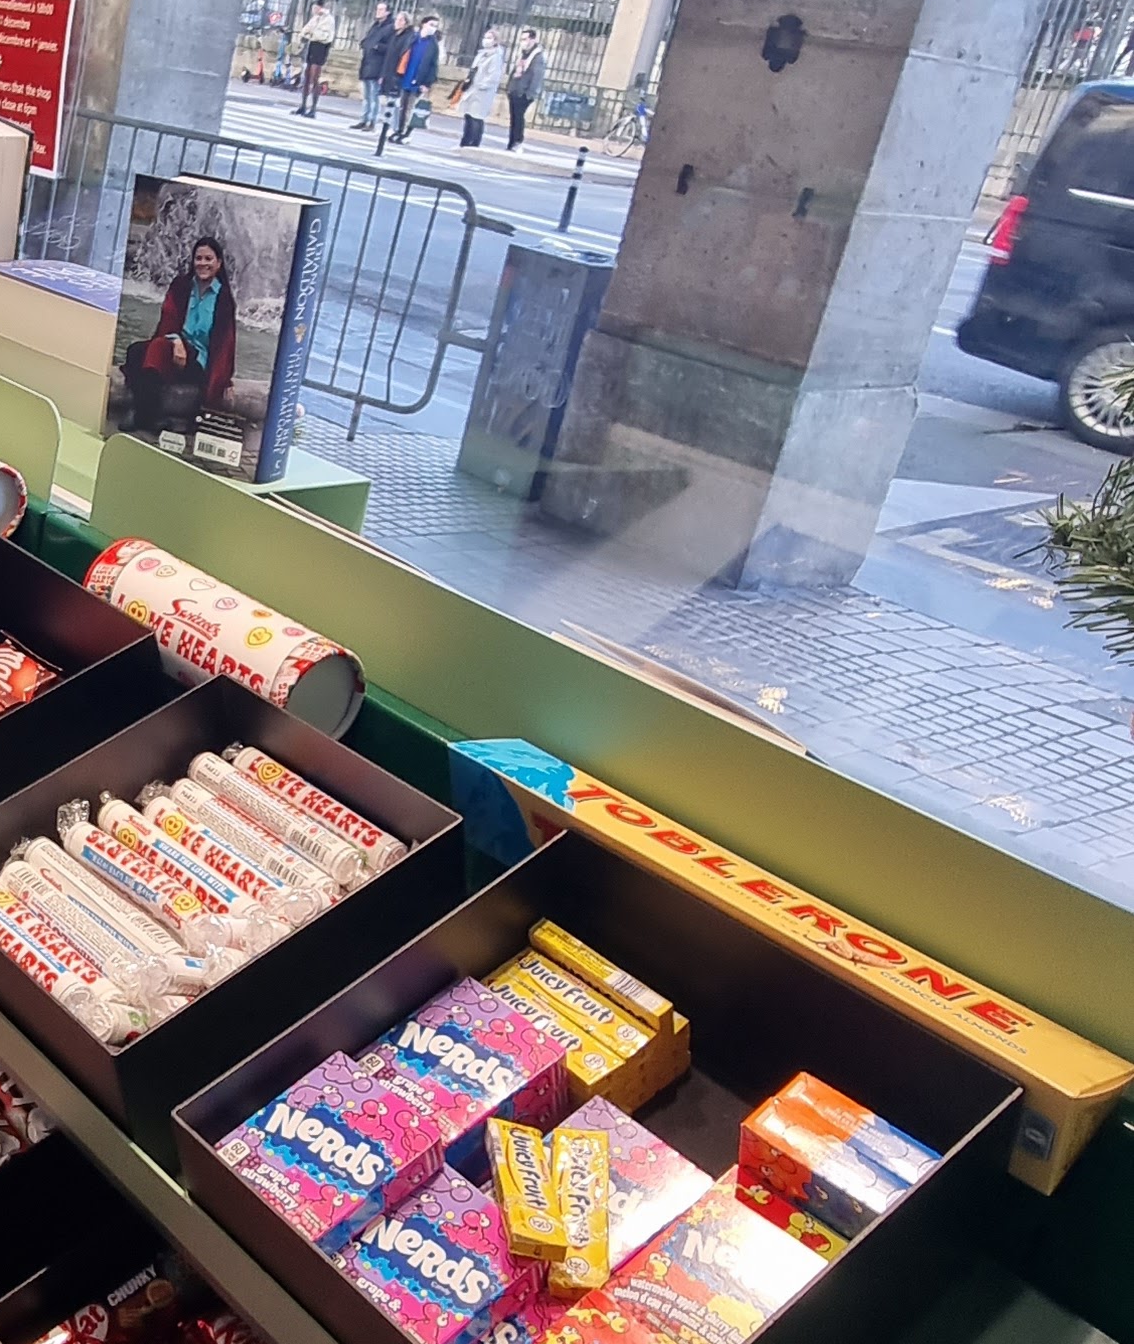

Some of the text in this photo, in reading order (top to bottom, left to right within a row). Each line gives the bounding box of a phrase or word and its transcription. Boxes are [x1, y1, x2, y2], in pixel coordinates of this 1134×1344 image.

[176, 628, 265, 693] HEARTS
[301, 790, 384, 850] HEARTS
[567, 784, 1035, 1035] TOBLERONE
[28, 923, 101, 985] HEARTS
[520, 958, 613, 1023] Juicy Fruit
[880, 971, 1028, 1055] CRUNCHY ALMONDS
[240, 1167, 300, 1210] strawberry
[257, 1163, 301, 1194] grape &
[107, 1264, 158, 1307] CHUNKY
